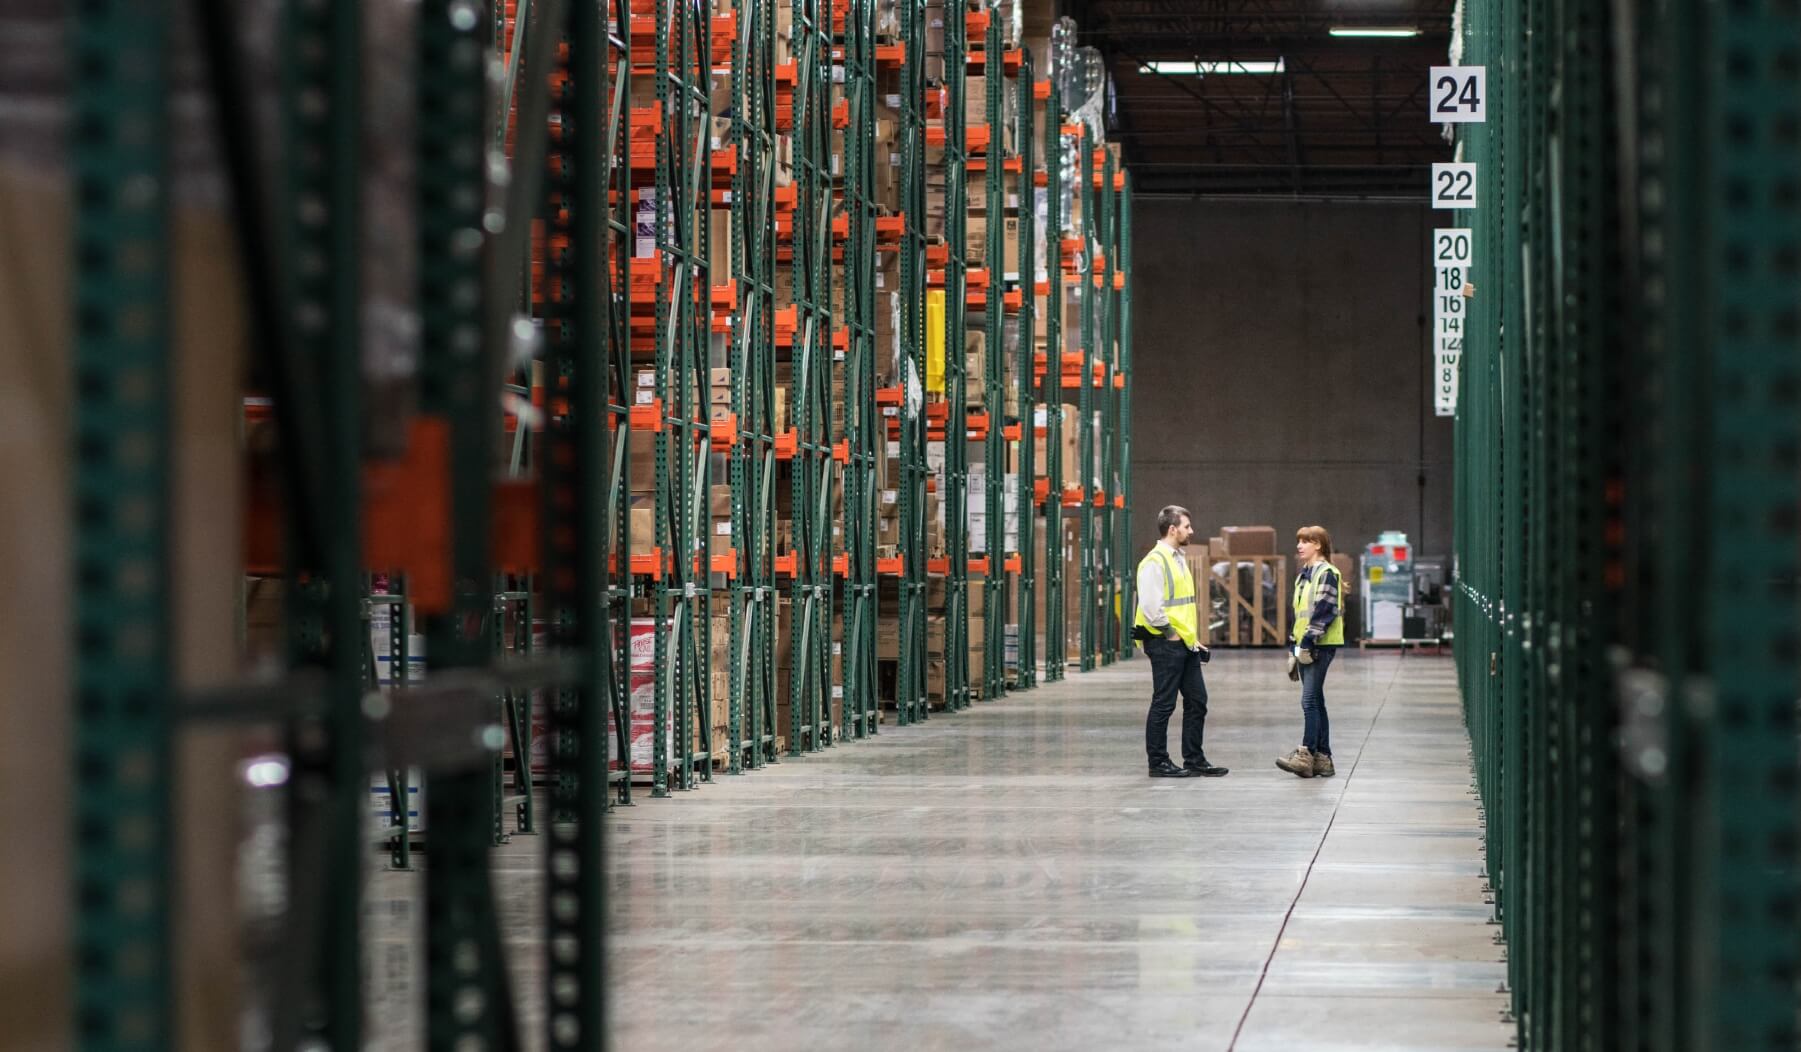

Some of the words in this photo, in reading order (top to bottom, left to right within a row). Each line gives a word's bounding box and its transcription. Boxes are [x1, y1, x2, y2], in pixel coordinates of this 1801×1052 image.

[1436, 75, 1480, 113] 24
[1437, 170, 1473, 200] 22
[1439, 234, 1469, 260] 20
[1441, 267, 1461, 290] 18
[1440, 295, 1461, 313] 16
[1440, 318, 1460, 333] 14
[1443, 368, 1452, 382] 8
